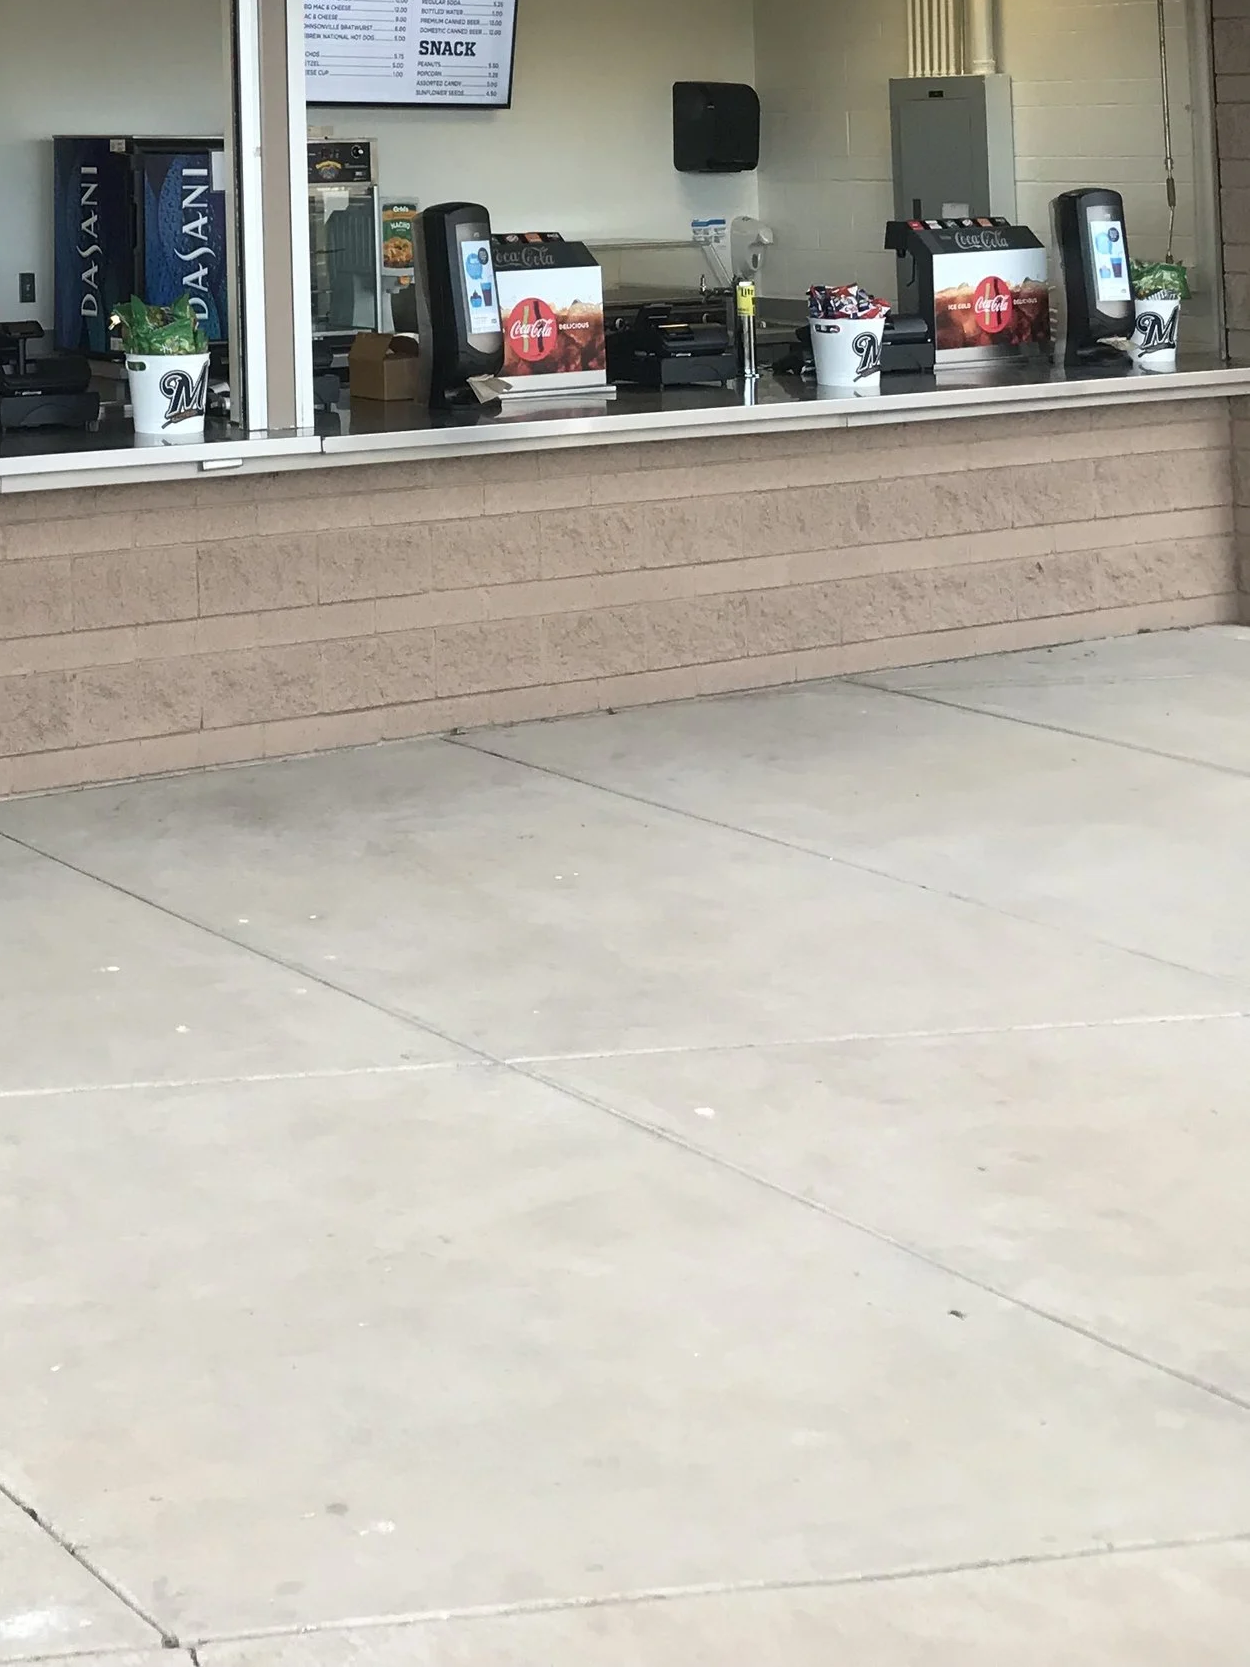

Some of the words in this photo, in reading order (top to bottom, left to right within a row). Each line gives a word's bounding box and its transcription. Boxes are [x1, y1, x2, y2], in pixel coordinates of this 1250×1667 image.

[418, 40, 476, 56] SNACK
[390, 222, 410, 230] NACHO
[76, 167, 103, 317] DASANI
[174, 168, 216, 320] DASANI
[955, 230, 1009, 250] Coca-Cola
[974, 294, 1010, 314] Coca-Cola
[1013, 298, 1038, 306] DELICIOUS
[510, 318, 554, 340] Coca-Cola
[558, 322, 590, 331] DELICIOUS
[159, 360, 210, 420] M
